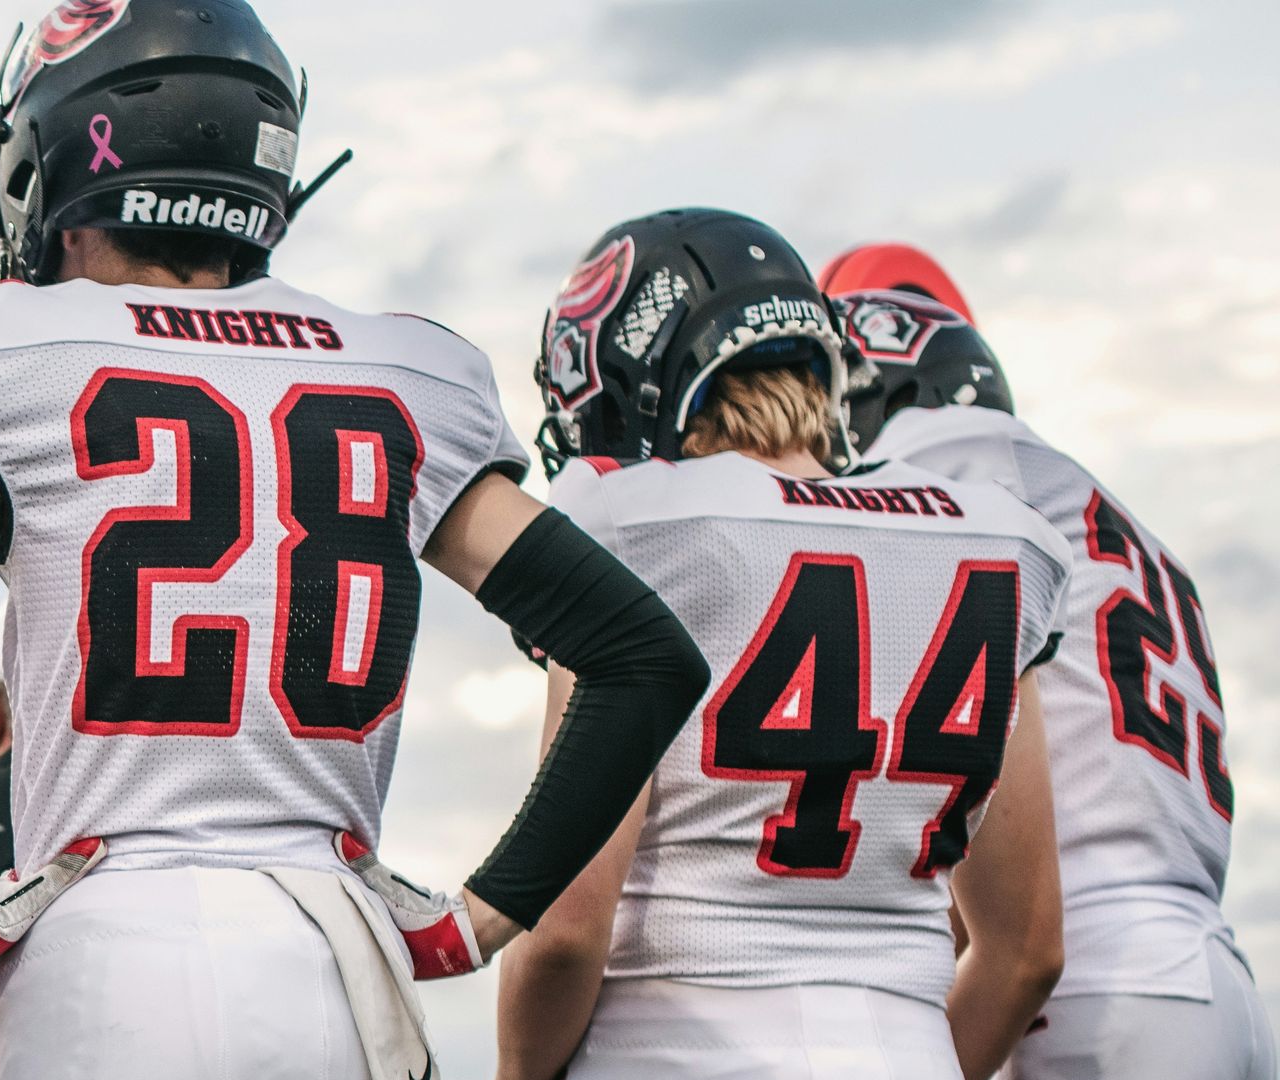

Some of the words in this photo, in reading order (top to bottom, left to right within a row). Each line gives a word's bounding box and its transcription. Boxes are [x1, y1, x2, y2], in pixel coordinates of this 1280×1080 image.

[121, 189, 269, 240] Riddell
[126, 303, 343, 351] KNIGHTS
[773, 475, 966, 519] KNIGHTS
[70, 367, 425, 743] 28
[701, 552, 1021, 879] 44
